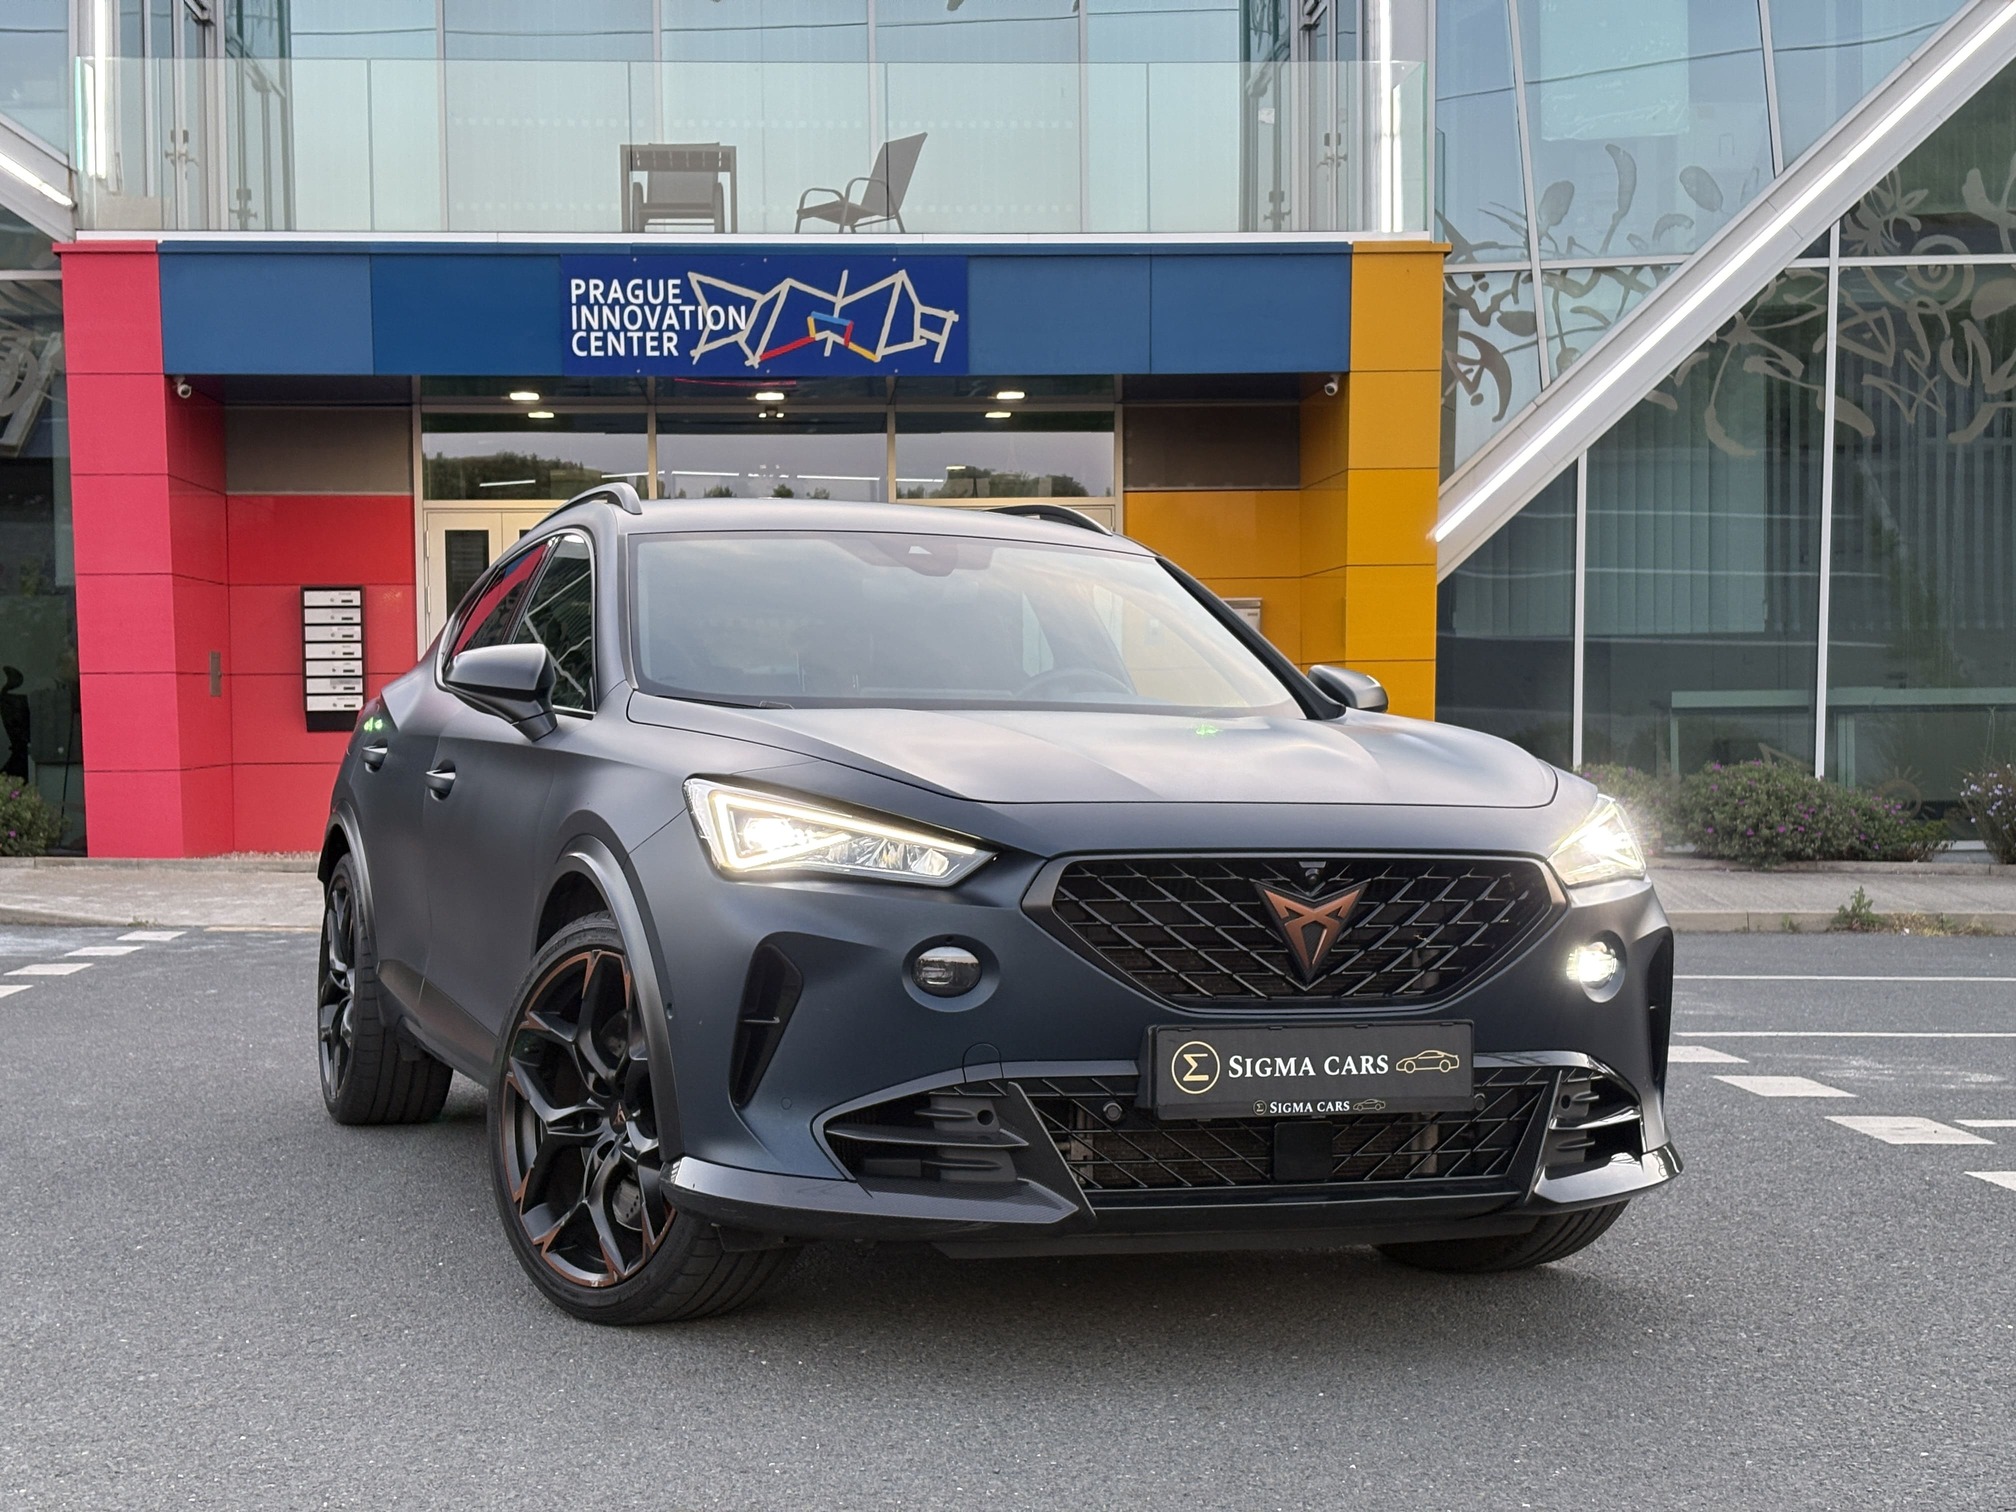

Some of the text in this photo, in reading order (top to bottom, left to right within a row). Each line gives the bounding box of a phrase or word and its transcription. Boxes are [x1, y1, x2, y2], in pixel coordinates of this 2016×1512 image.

[570, 278, 682, 305] PRAGUE
[571, 305, 746, 331] INNOVATION
[571, 331, 679, 357] CENTER
[1228, 1055, 1389, 1078] SIGMA CARS
[1269, 1101, 1350, 1113] SIGMA CARS
